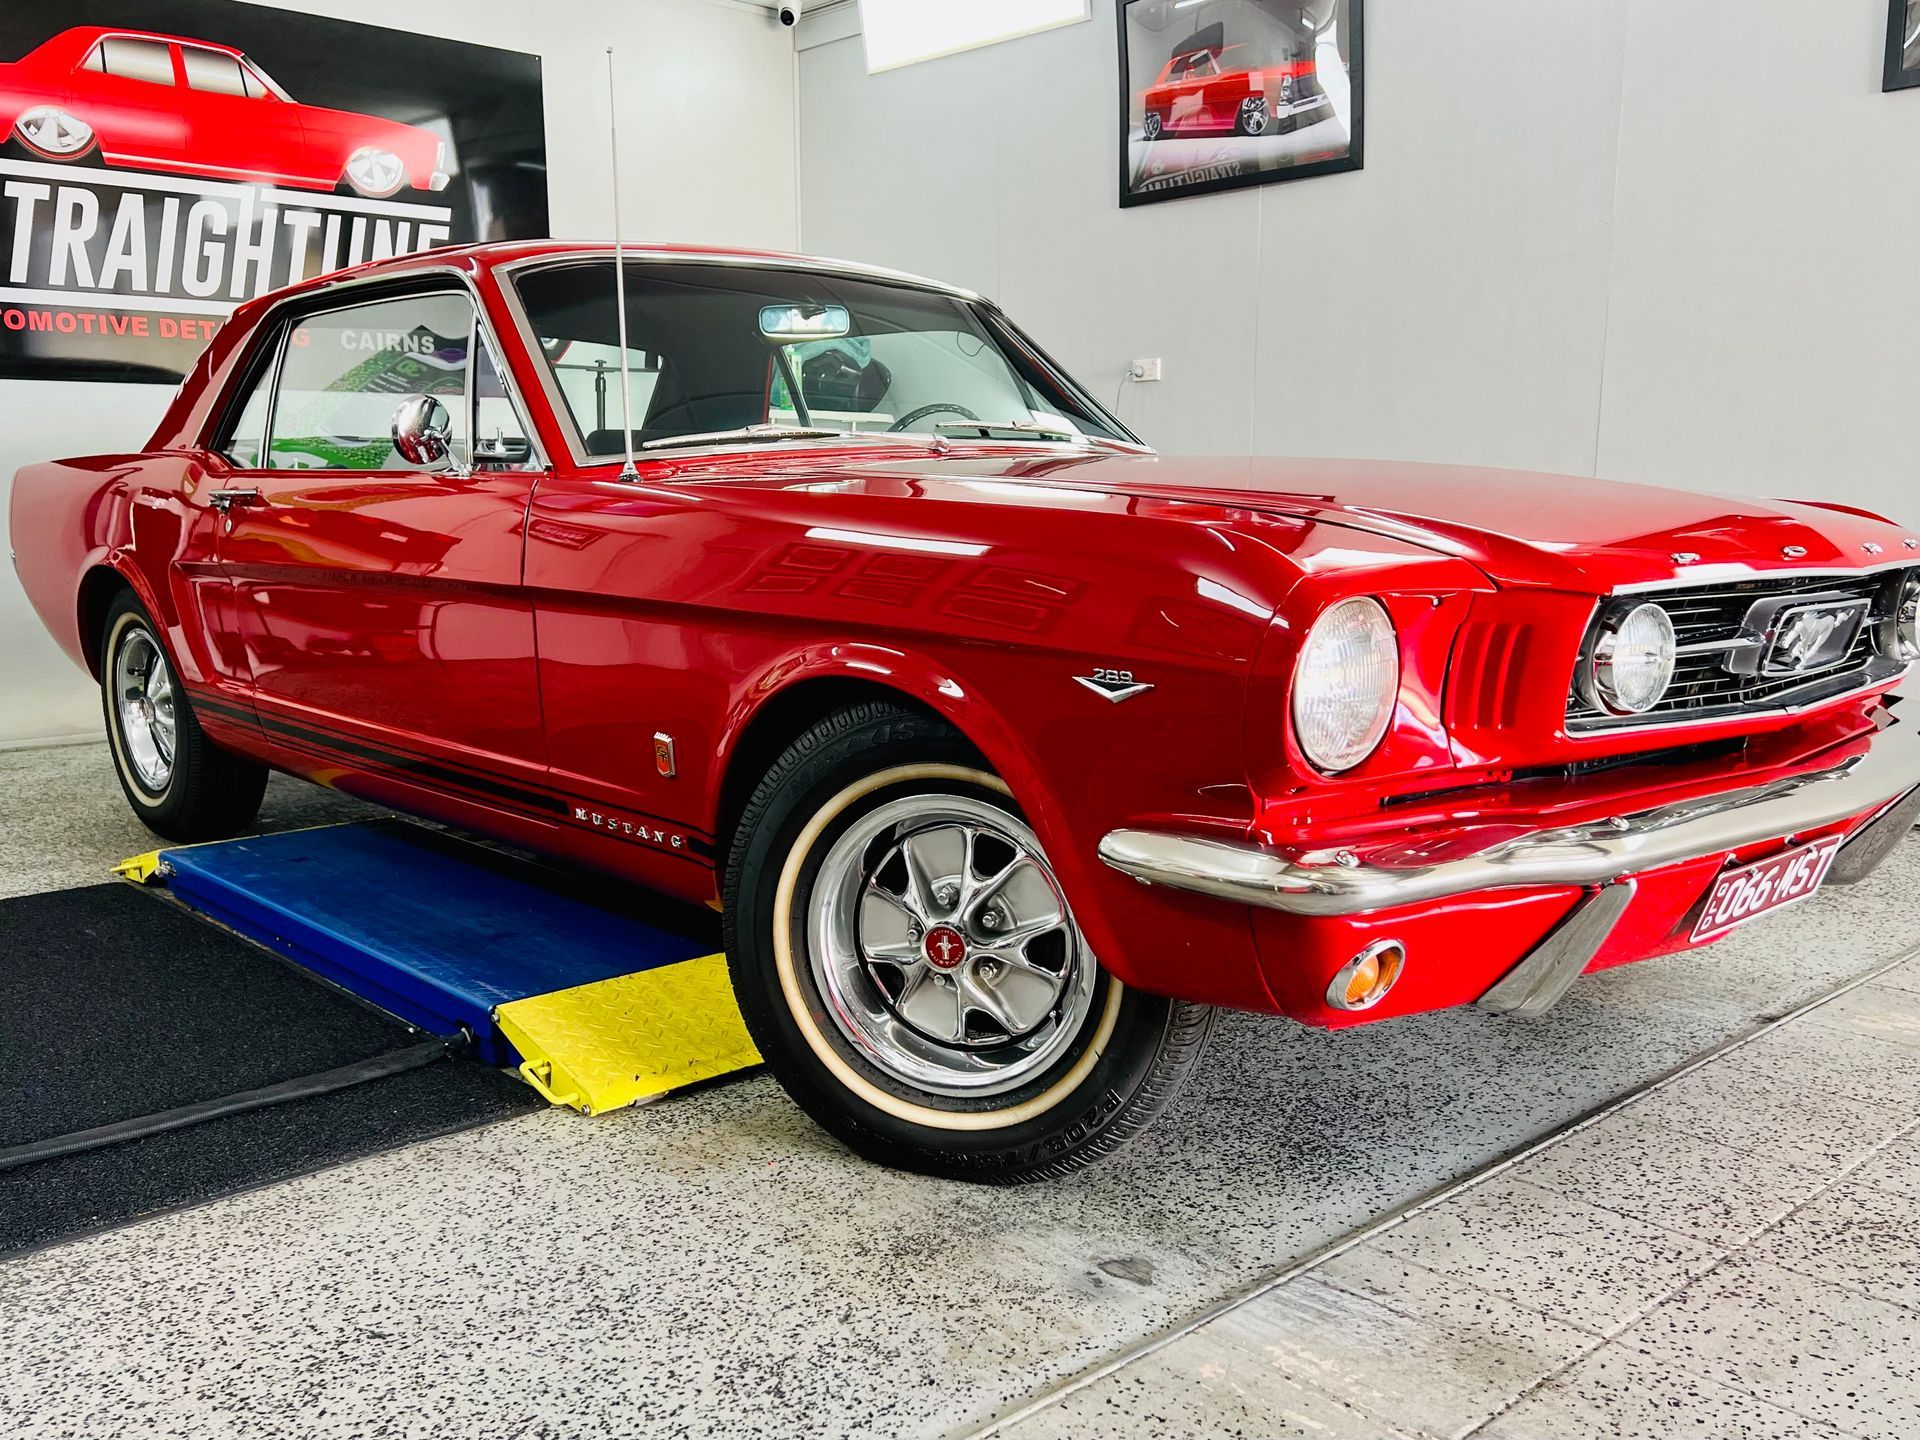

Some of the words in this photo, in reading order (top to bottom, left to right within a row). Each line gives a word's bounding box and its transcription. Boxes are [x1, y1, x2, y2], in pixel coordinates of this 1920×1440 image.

[0, 307, 150, 338] OMOTIVE
[340, 330, 436, 354] CAIRNS
[1093, 668, 1133, 684] 289
[575, 807, 683, 848] MUSTANG
